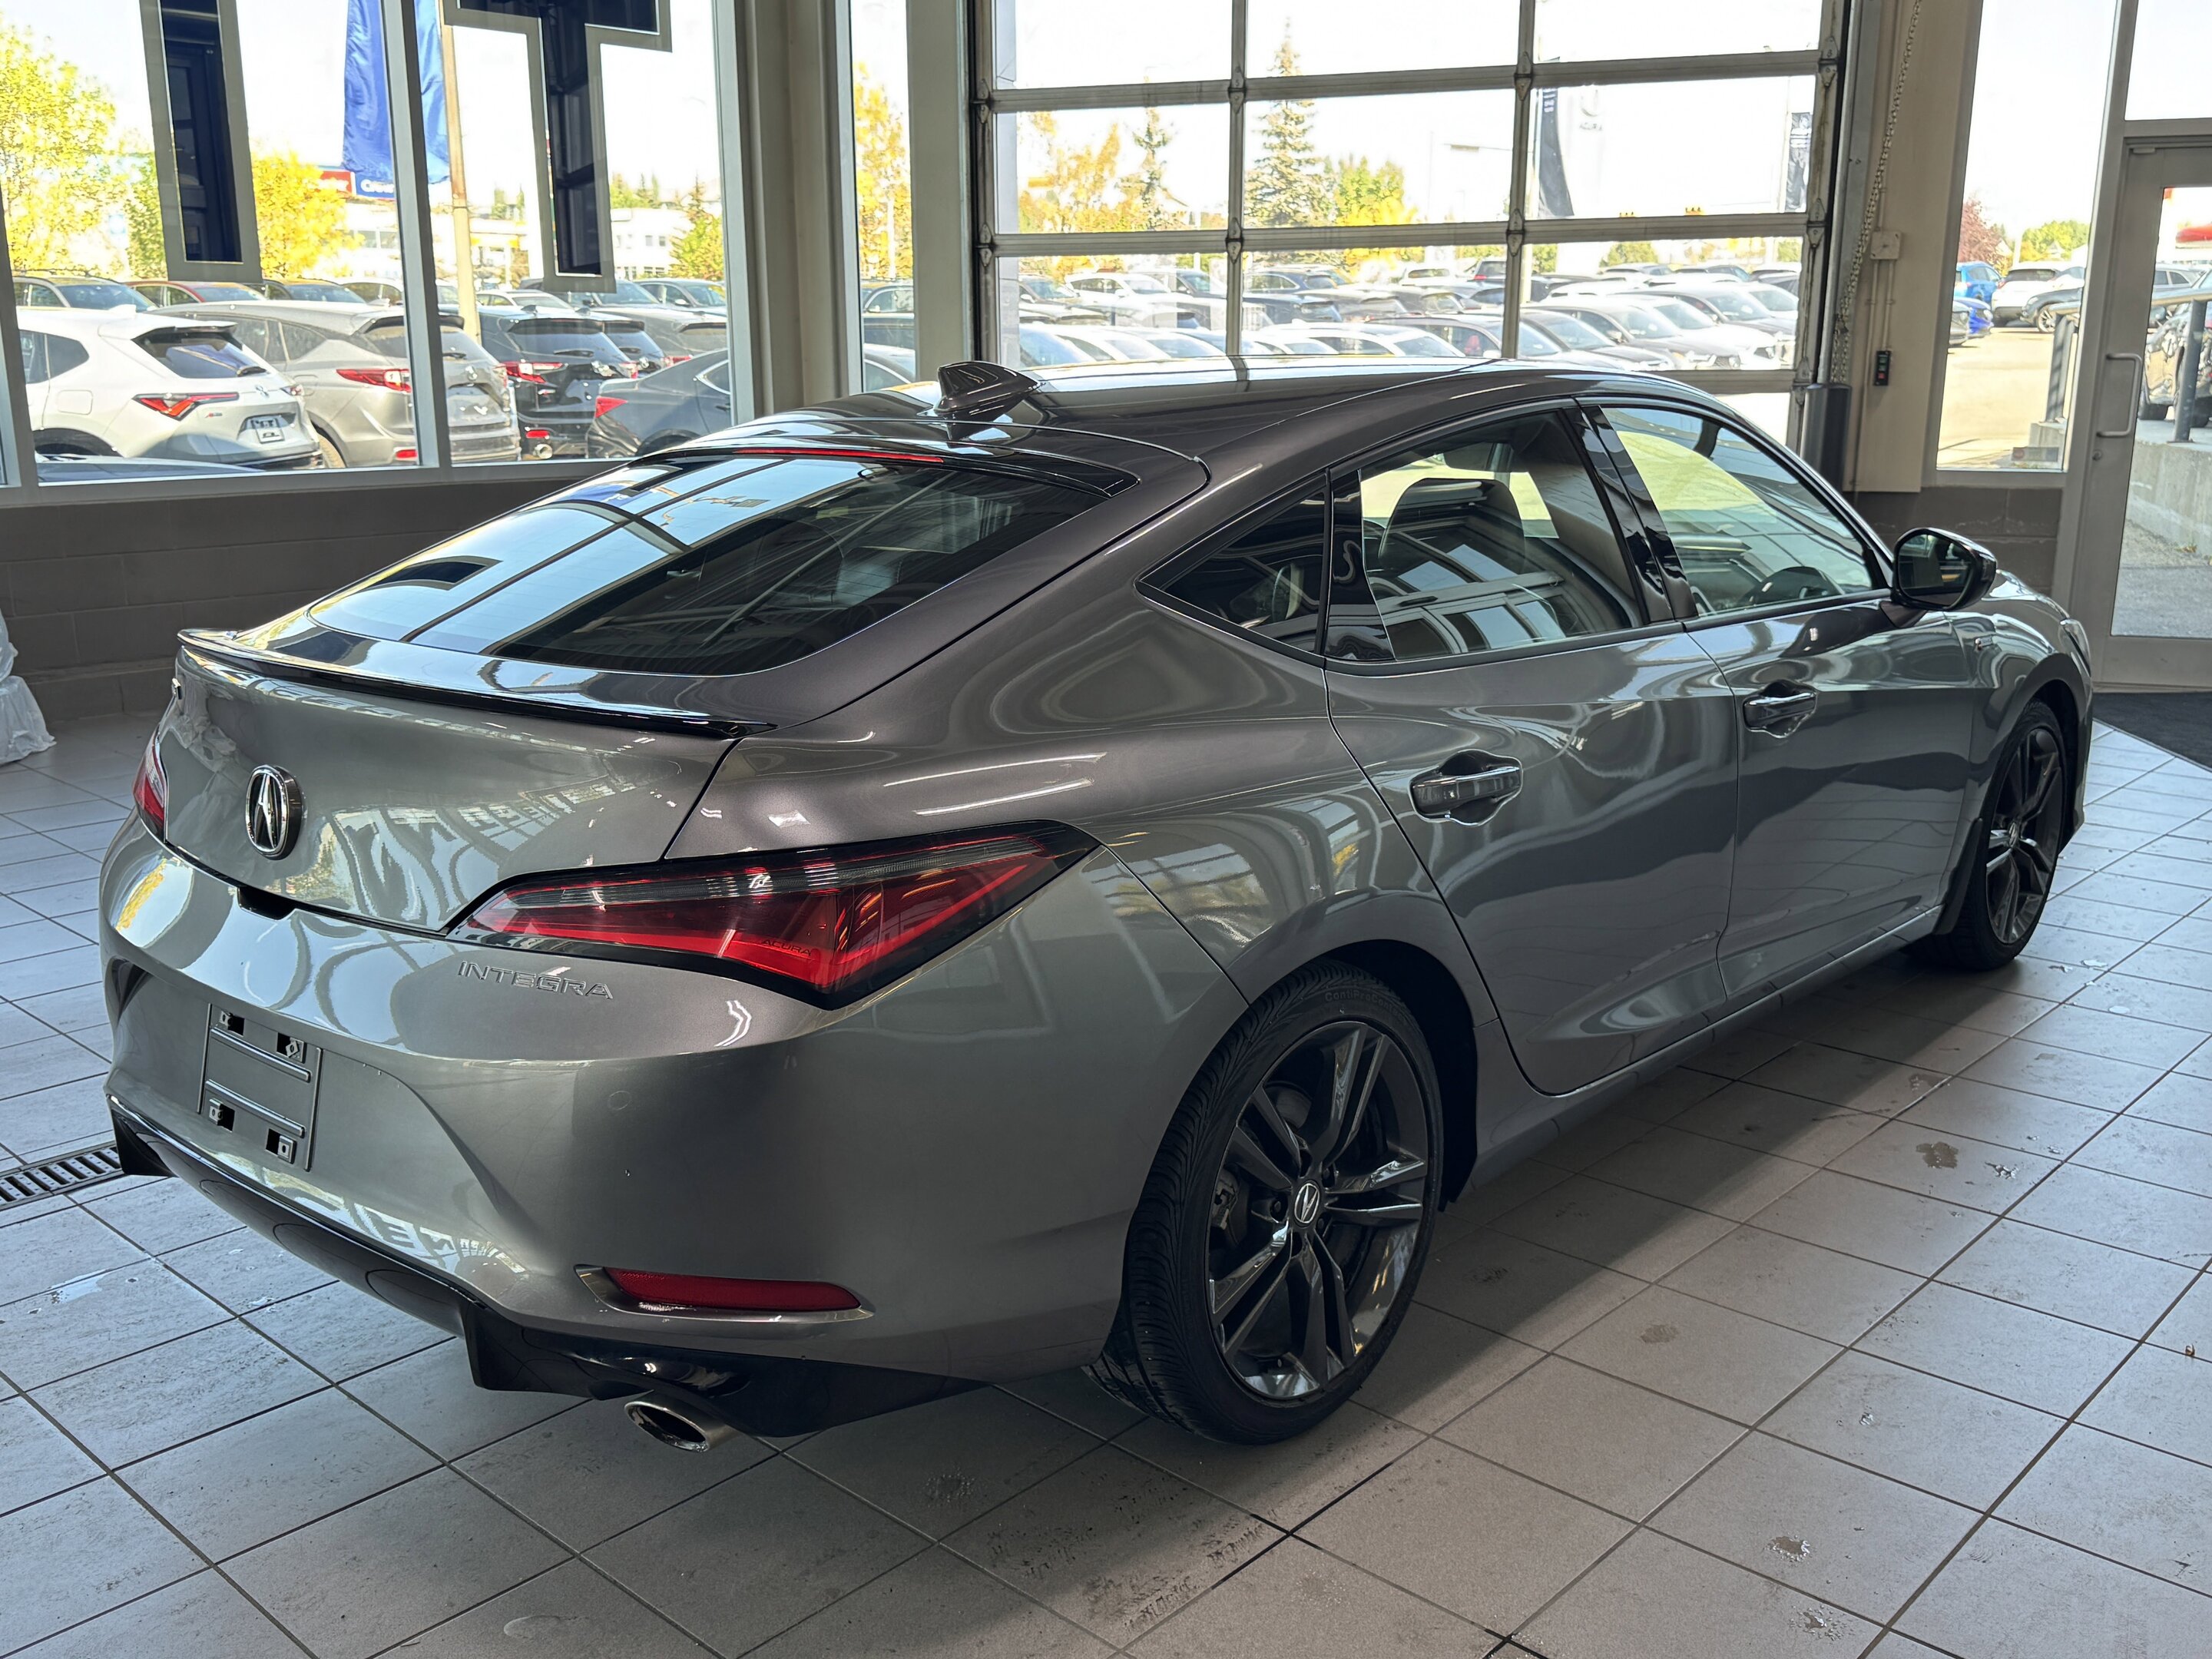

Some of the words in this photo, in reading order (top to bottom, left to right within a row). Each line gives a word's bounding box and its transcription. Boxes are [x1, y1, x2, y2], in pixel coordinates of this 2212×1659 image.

[761, 939, 811, 956] ACURA
[458, 960, 614, 999] INTEGRA
[1325, 989, 1406, 1026] ContiProCont
